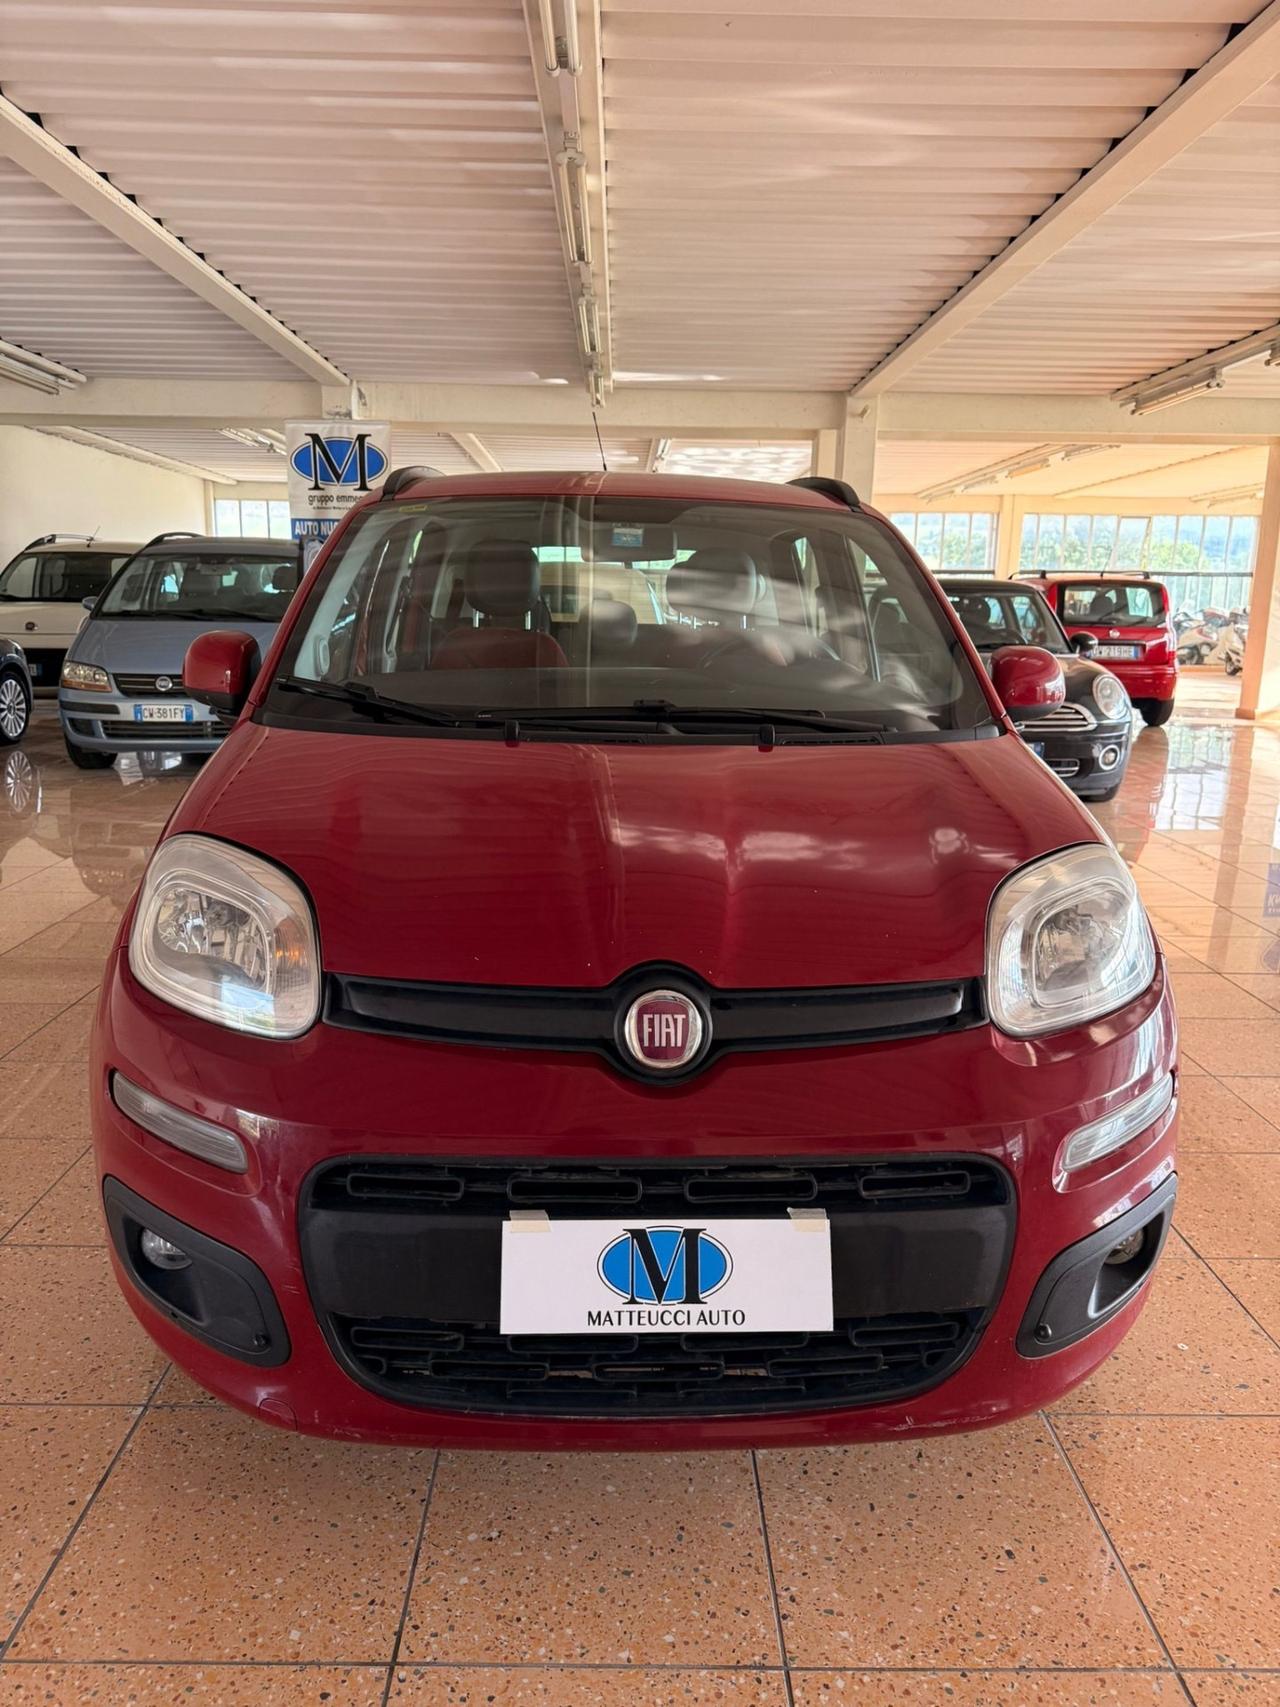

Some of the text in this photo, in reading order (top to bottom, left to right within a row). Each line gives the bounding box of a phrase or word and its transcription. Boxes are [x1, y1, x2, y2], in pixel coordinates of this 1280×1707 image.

[304, 433, 373, 491] M
[308, 494, 335, 506] gruppo
[295, 521, 319, 536] AUTO
[643, 1014, 686, 1047] FIAT
[622, 1228, 707, 1305] M
[587, 1309, 746, 1326] MATTEUCCI AUTO
